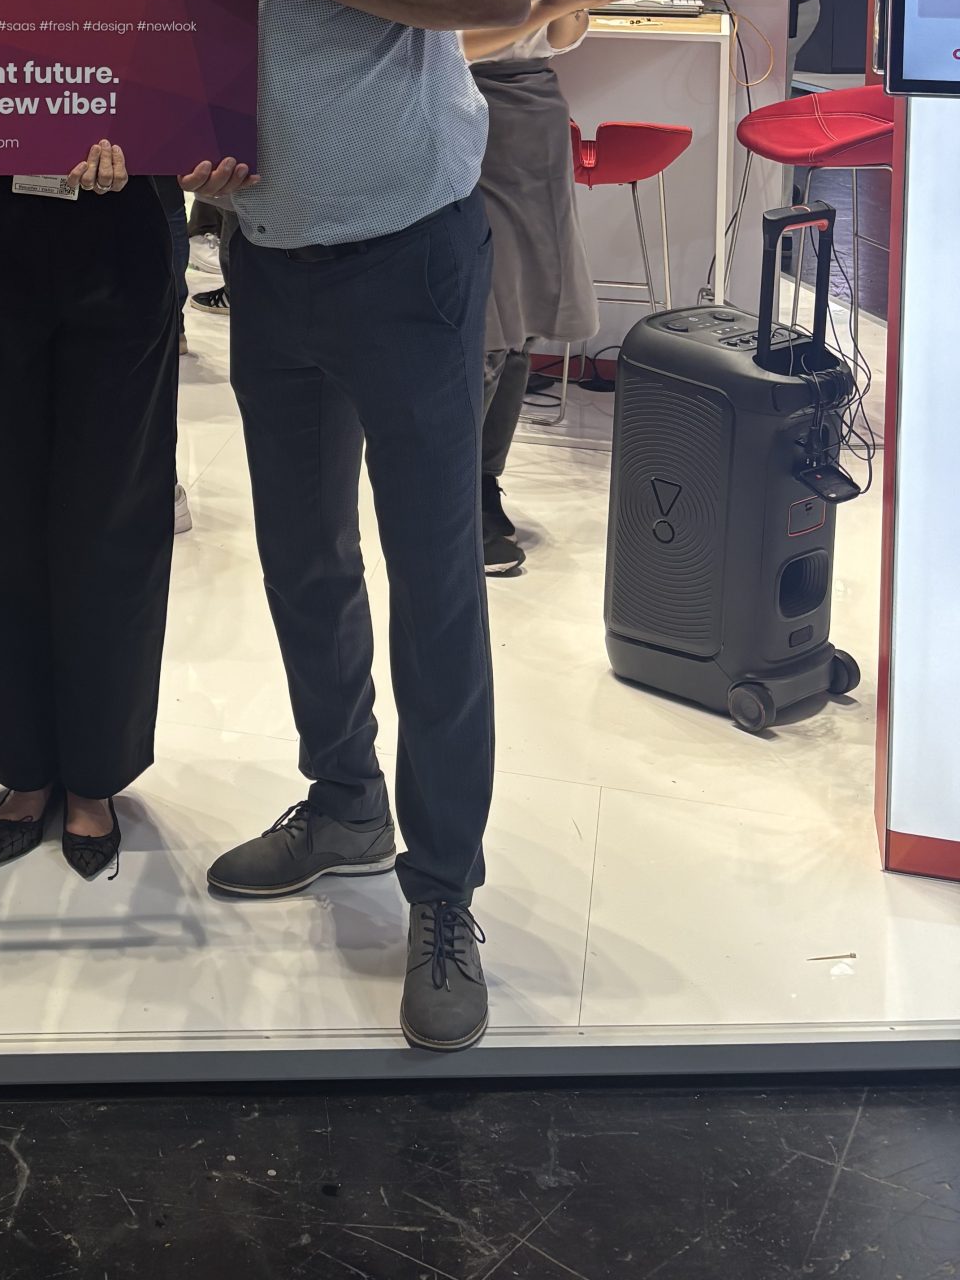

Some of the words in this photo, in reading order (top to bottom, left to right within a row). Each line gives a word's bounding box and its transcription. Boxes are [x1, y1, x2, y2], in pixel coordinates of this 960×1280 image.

[39, 20, 79, 31] #fresh
[83, 20, 134, 34] #design
[137, 21, 197, 32] #newlook
[24, 60, 120, 84] future.
[45, 90, 117, 115] vibe!
